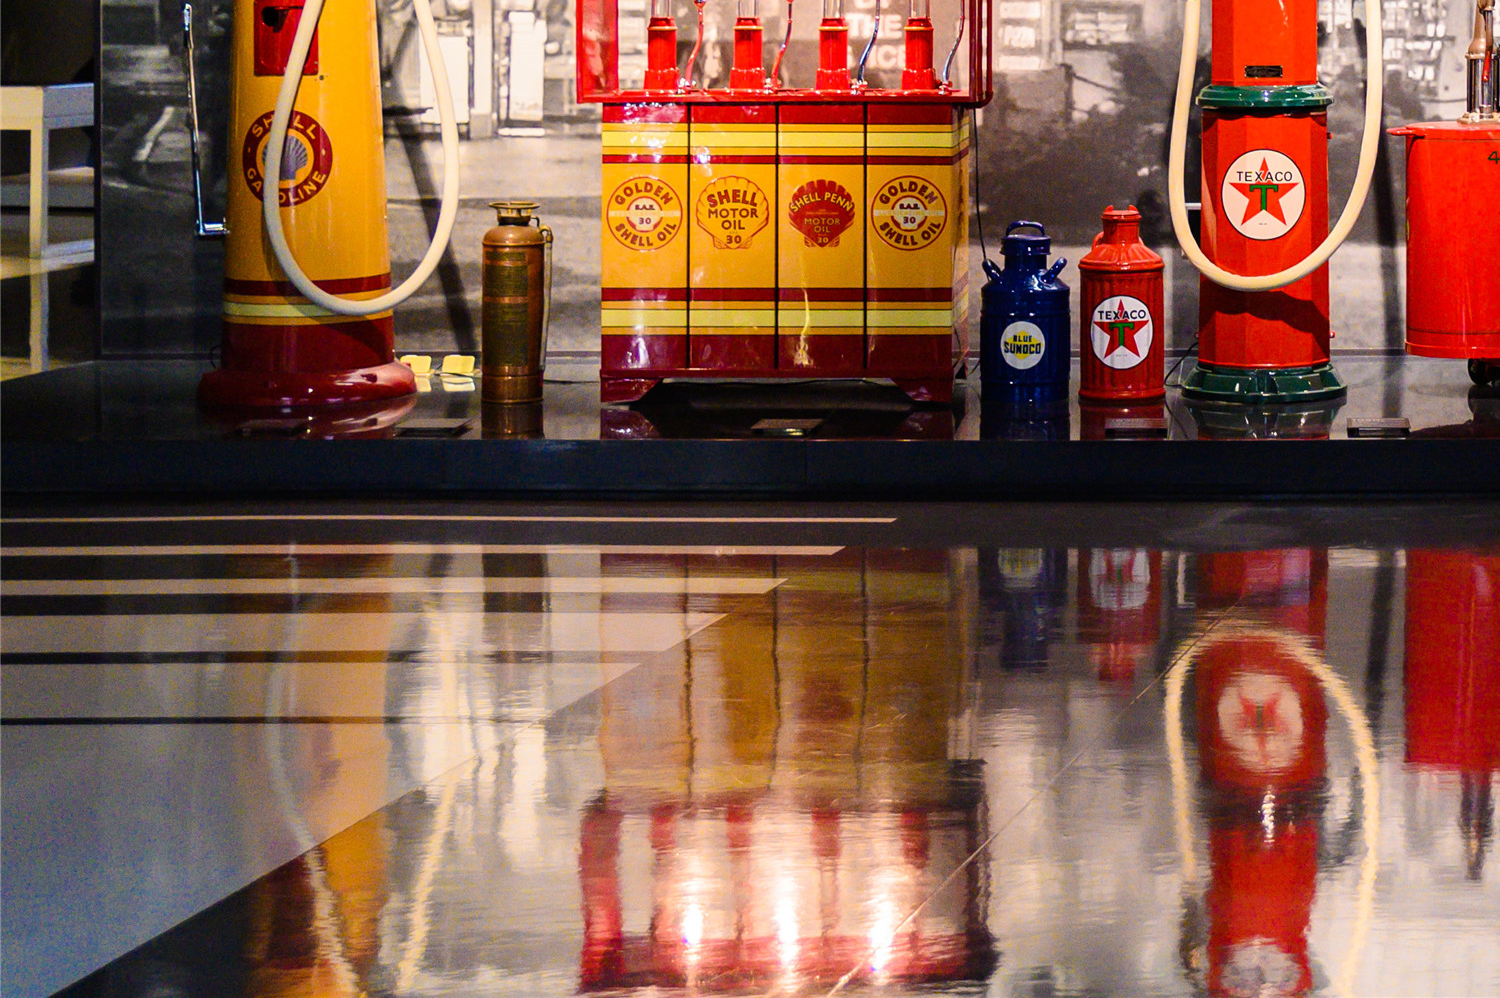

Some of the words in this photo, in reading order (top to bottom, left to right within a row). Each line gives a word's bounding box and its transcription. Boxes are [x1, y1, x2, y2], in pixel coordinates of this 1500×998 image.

[845, 13, 903, 39] THE
[252, 114, 316, 138] SHLL
[1236, 170, 1293, 182] TEXACO
[247, 168, 326, 203] GAOLINE
[614, 182, 674, 205] GOLDEN
[706, 188, 757, 208] SHELL
[879, 181, 939, 205] GOLDEN
[708, 208, 759, 219] MOTOR
[638, 217, 652, 225] 30
[721, 219, 746, 230] OIL
[804, 217, 841, 226] MOTOR
[903, 216, 917, 224] 30
[615, 223, 654, 247] SHELL
[656, 222, 677, 242] OIL
[814, 225, 830, 233] OIL
[879, 221, 918, 246] SHELL
[921, 221, 942, 241] OIL
[726, 235, 742, 244] 30
[1097, 309, 1147, 321] TEXACO
[1013, 334, 1033, 343] BLUE
[1003, 341, 1042, 355] SUNOCO
